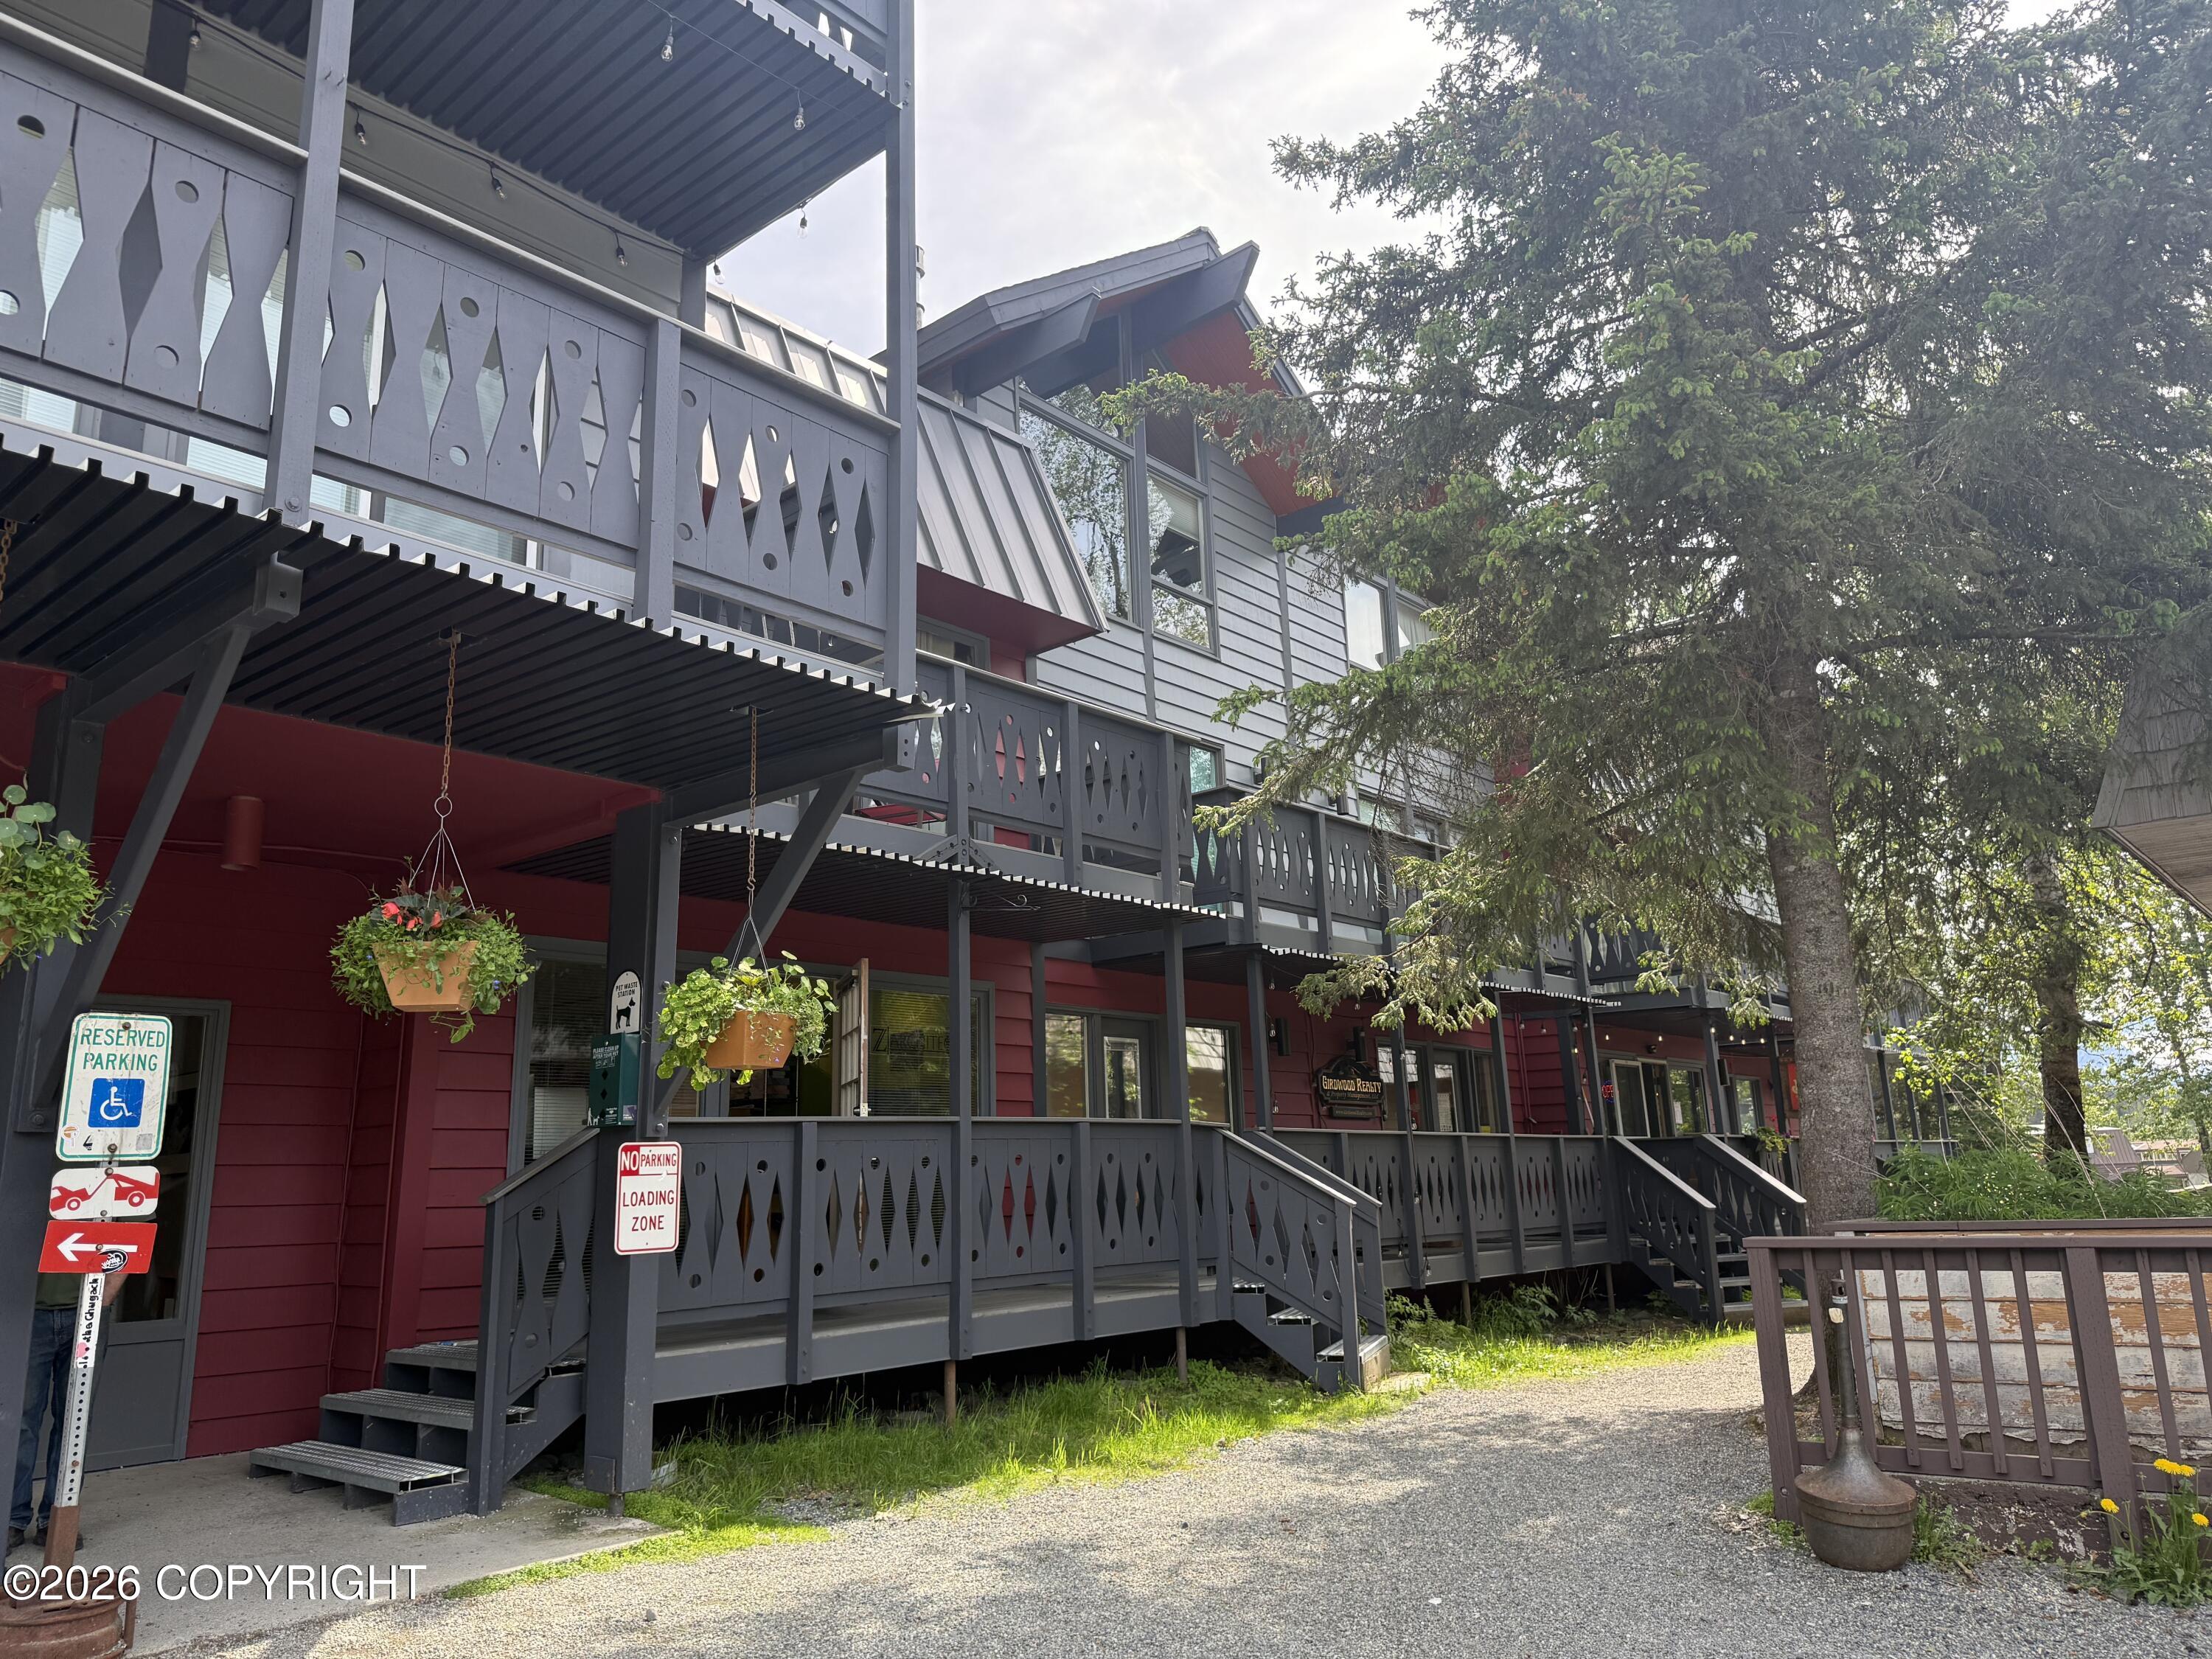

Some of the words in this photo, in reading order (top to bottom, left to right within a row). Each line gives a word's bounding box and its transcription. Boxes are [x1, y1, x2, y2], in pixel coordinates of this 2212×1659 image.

[617, 989, 636, 998] STATION
[624, 981, 638, 990] WASTE
[80, 1029, 165, 1048] RESERVED
[873, 1028, 887, 1051] Z
[83, 1053, 158, 1071] PARKING
[1601, 1085, 1615, 1098] OPE
[621, 1150, 639, 1171] NO
[640, 1153, 677, 1167] PARKING
[622, 1190, 675, 1207] LOADING
[631, 1215, 664, 1231] ZONE
[85, 1278, 99, 1321] Chugach
